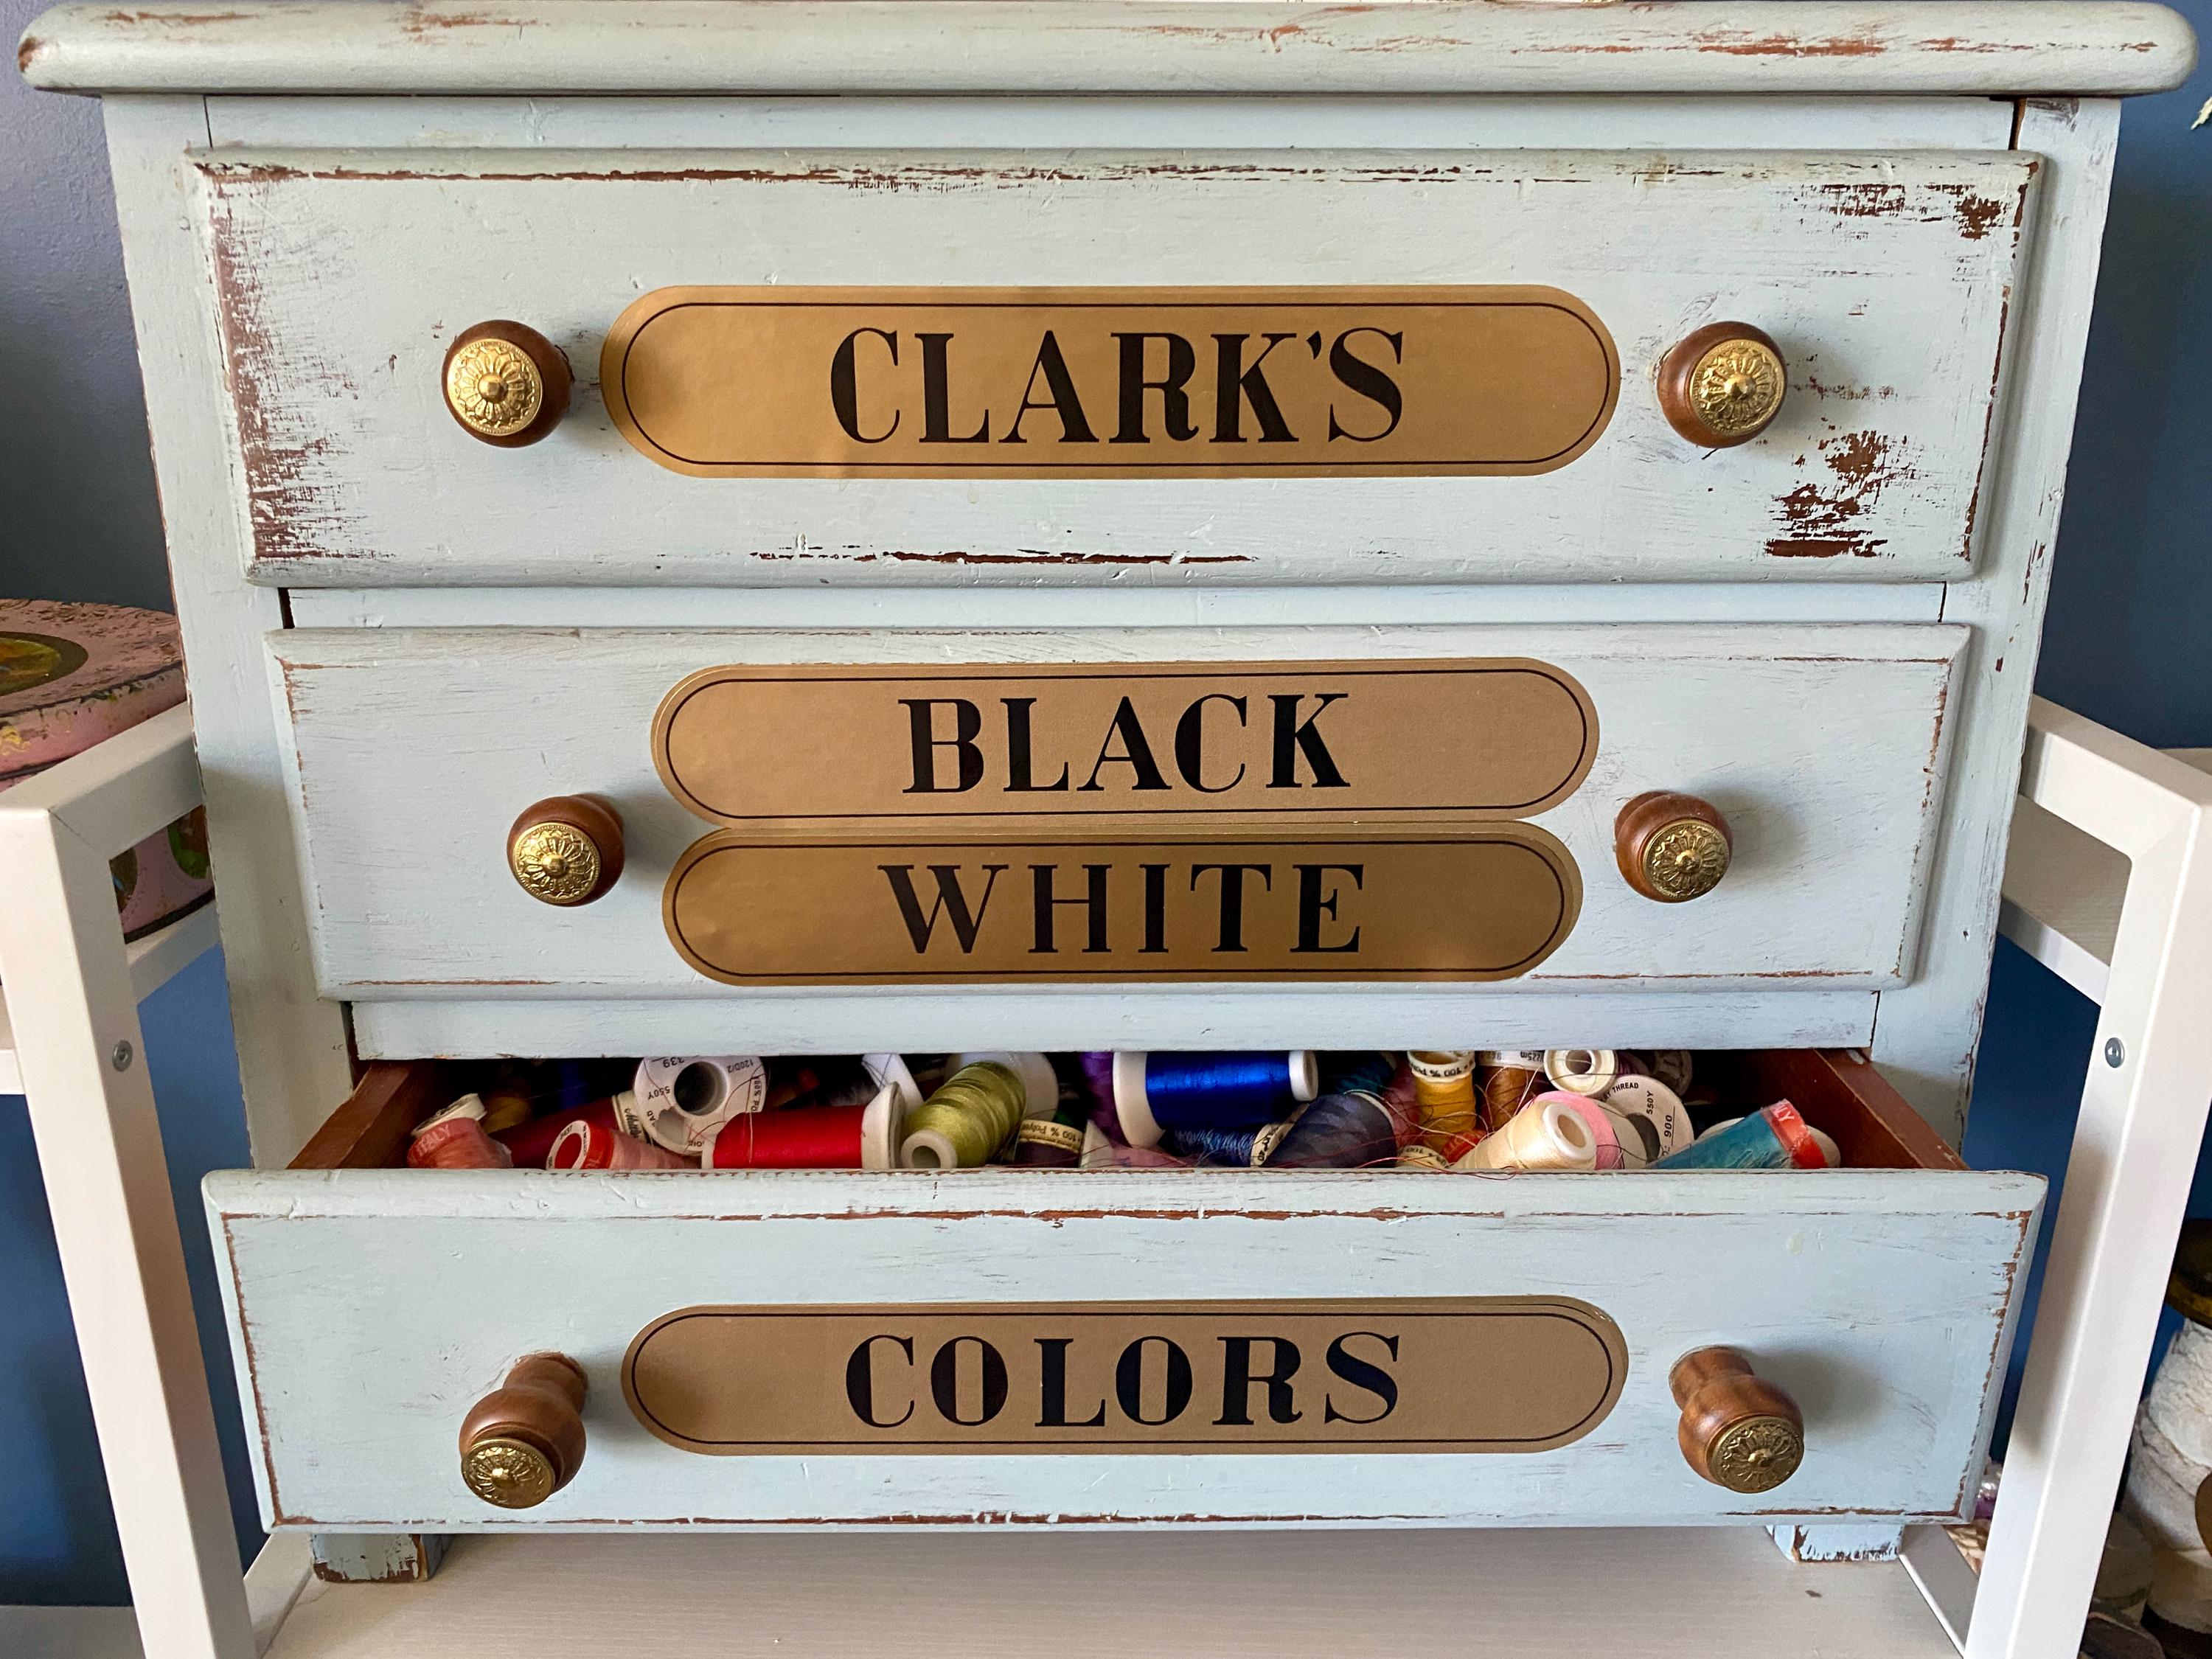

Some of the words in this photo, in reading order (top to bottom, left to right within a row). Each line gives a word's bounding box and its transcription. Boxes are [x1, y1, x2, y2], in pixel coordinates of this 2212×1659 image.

[830, 327, 1403, 444] CLARK'S
[897, 693, 1352, 793] BLACK
[877, 863, 1365, 954] WHITE
[727, 1058, 754, 1074] 120D/2
[647, 1085, 671, 1101] 550Y
[1611, 1082, 1639, 1093] THREAD
[1646, 1090, 1655, 1115] 550Y
[415, 1124, 451, 1157] ITALY
[1663, 1114, 1672, 1138] 900
[846, 1331, 1399, 1428] COLORS
